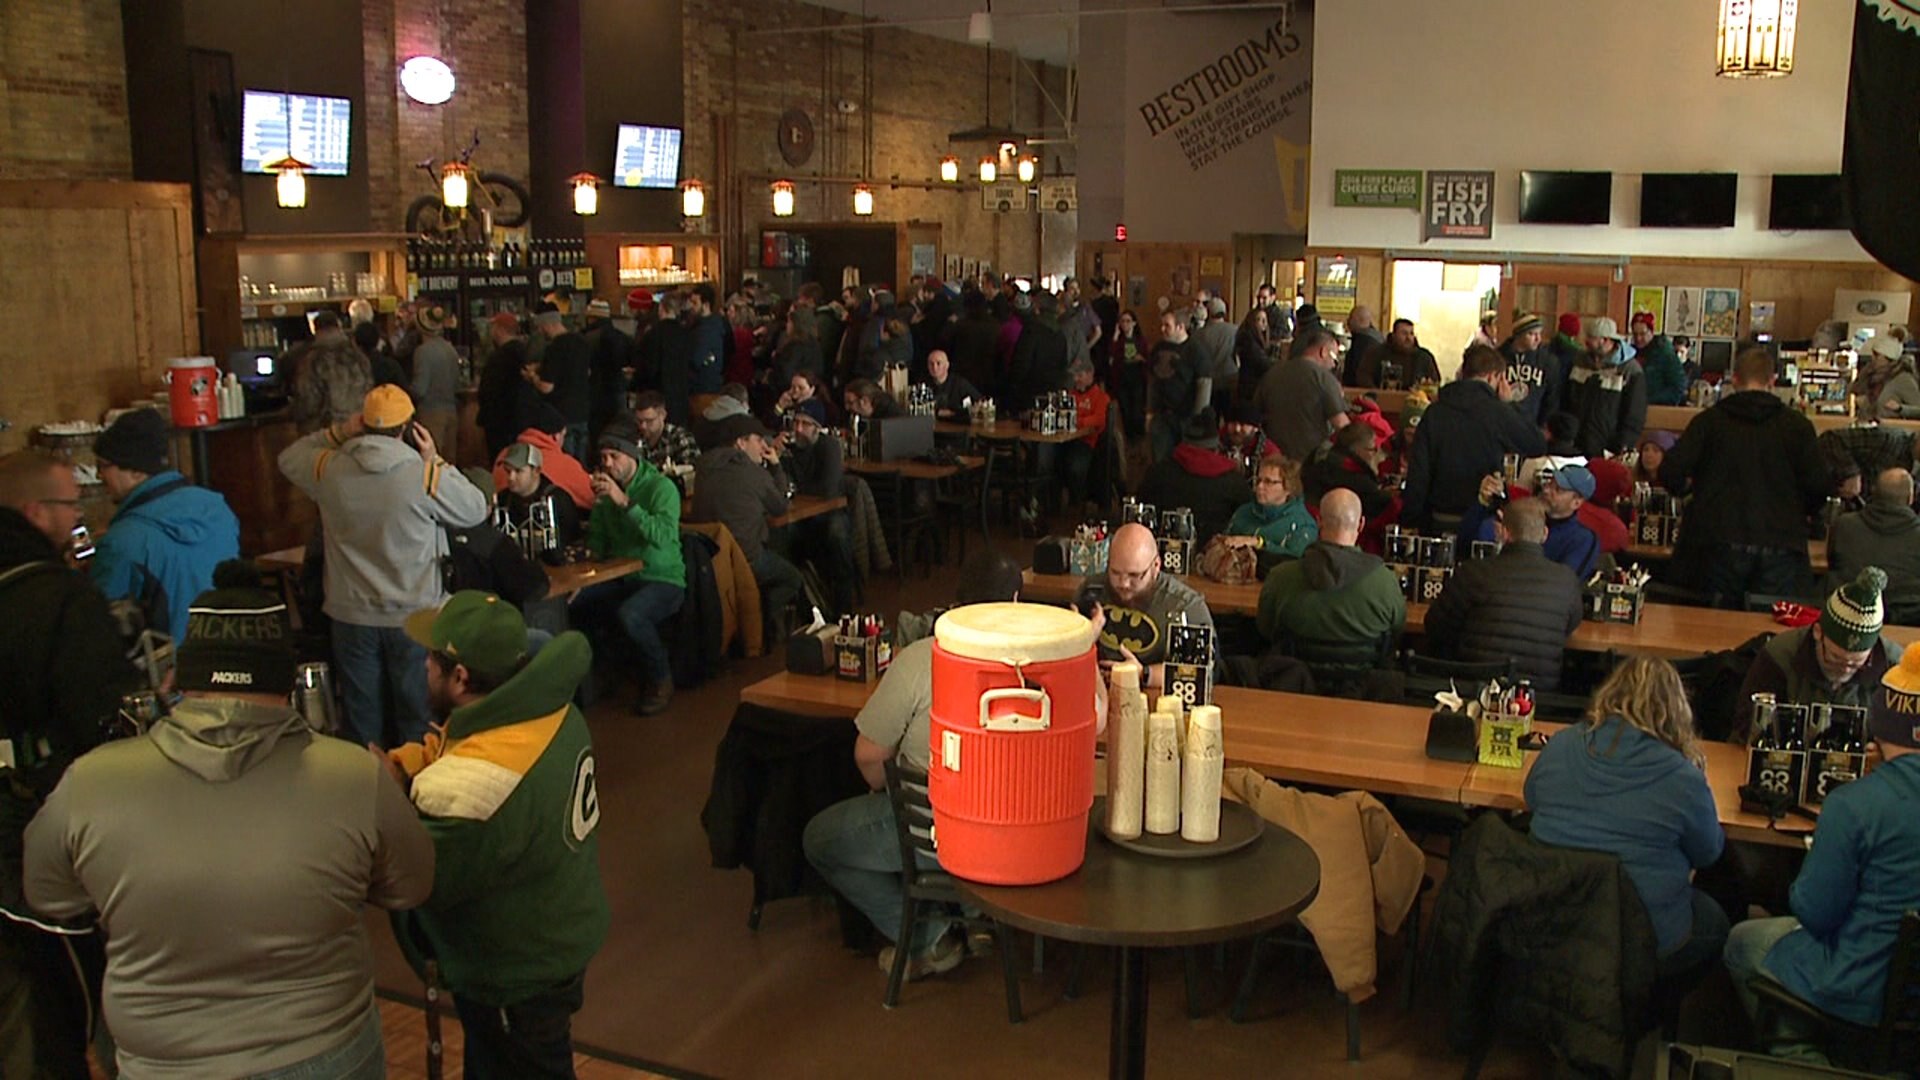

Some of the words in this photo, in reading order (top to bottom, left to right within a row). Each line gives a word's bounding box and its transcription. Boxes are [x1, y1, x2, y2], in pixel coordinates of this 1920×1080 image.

[1139, 19, 1301, 137] RESTROOMS
[1191, 110, 1214, 129] THE
[1215, 94, 1241, 116] GIFT
[1180, 129, 1206, 151] NOT
[1183, 135, 1219, 160] WALK
[1220, 101, 1277, 138] STRAIGHT
[1190, 148, 1218, 172] STAY
[1221, 135, 1244, 154] THE
[1341, 184, 1378, 193] CHEESE
[1381, 184, 1416, 193] CURDS
[1432, 182, 1488, 202] FISH
[1432, 202, 1488, 226] FRY
[1643, 526, 1659, 541] 88
[1164, 552, 1182, 569] 88
[1424, 581, 1444, 599] 88
[187, 612, 283, 641] PACKERS
[210, 670, 254, 685] PACKERS
[1172, 681, 1196, 705] 88
[1759, 769, 1790, 795] 88
